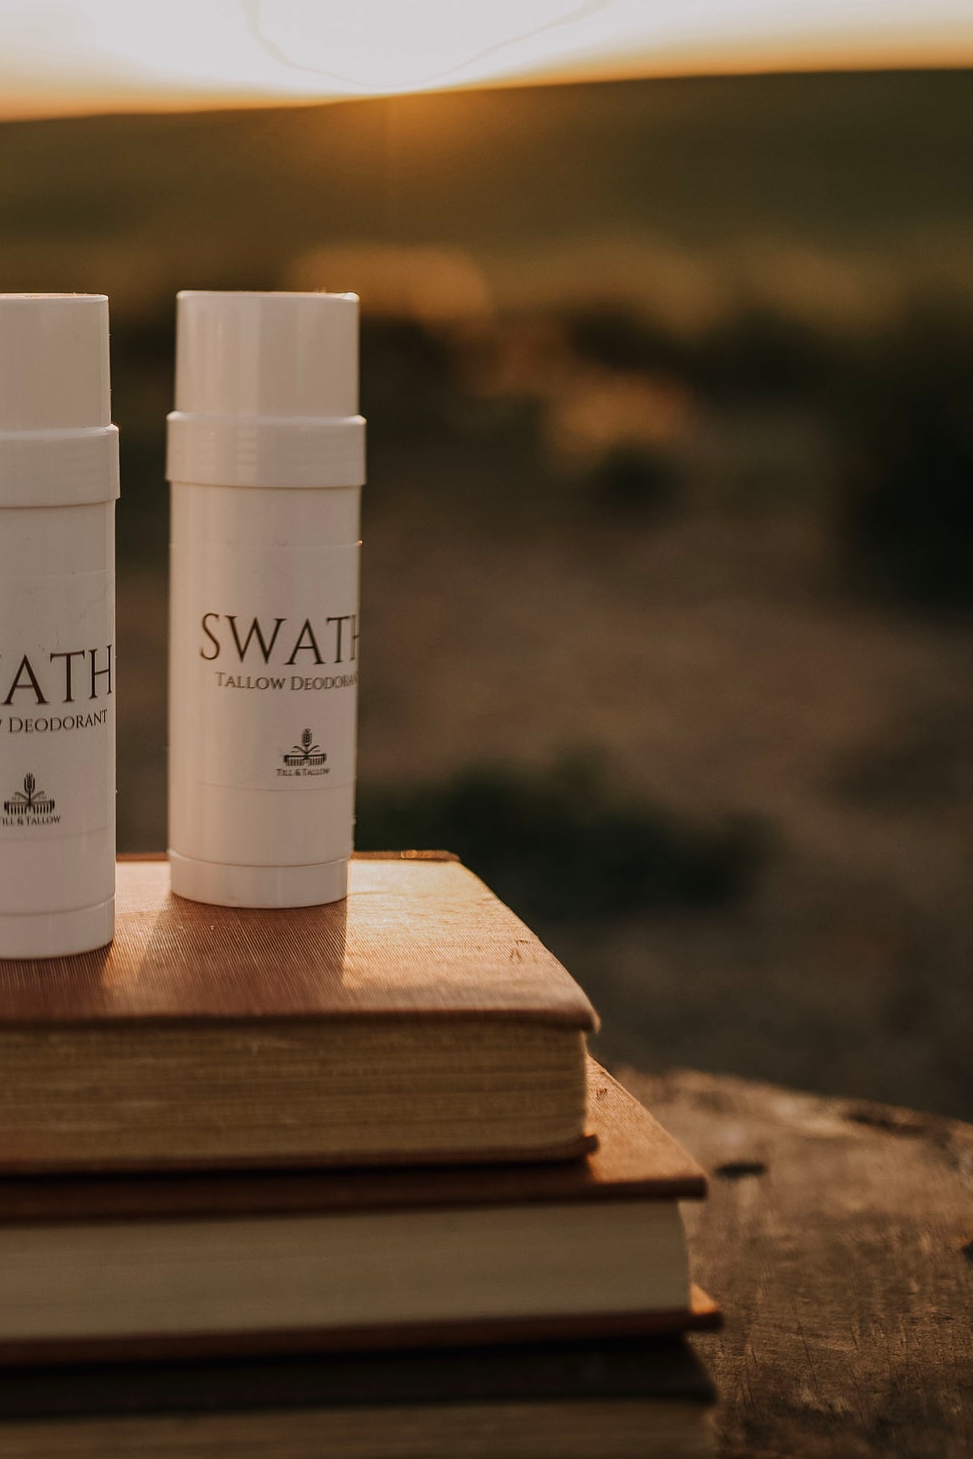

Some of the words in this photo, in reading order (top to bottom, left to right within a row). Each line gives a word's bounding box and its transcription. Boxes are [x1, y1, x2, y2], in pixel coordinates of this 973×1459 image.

[215, 671, 286, 690] TALLOW
[9, 709, 108, 733] DEODORANT
[17, 817, 24, 826] &
[25, 815, 61, 826] TALLOW
